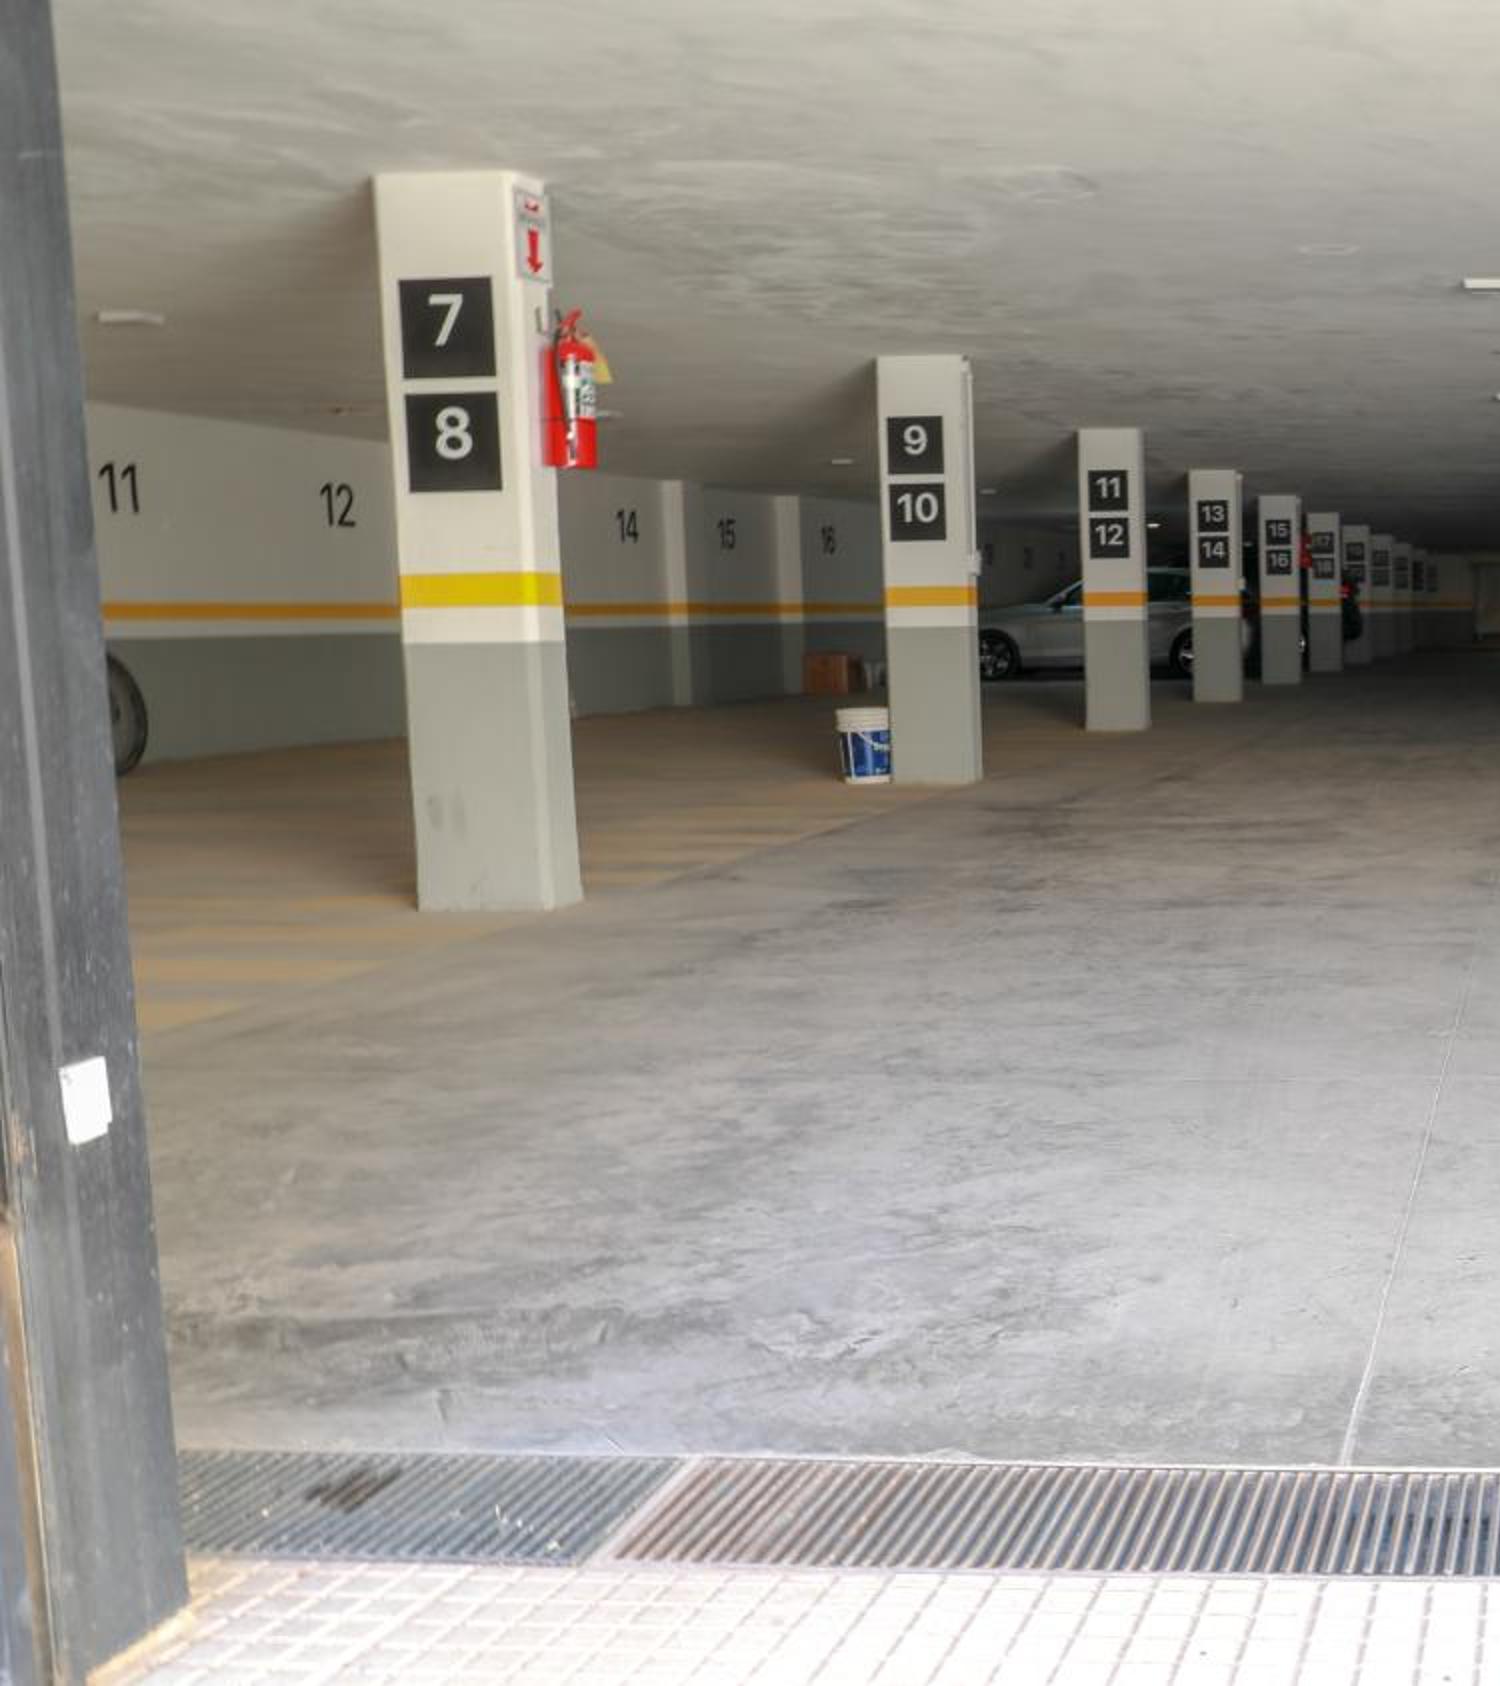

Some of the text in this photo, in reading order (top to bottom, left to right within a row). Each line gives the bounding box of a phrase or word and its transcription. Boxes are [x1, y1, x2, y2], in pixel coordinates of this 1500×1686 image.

[429, 293, 463, 346] 7
[435, 406, 473, 460] 8
[903, 425, 928, 455] 9
[98, 462, 139, 514] 11
[1096, 477, 1120, 498] 11
[320, 483, 356, 528] 12
[897, 492, 939, 523] 10
[1202, 505, 1225, 523] 13
[616, 509, 640, 543] 14
[1095, 523, 1124, 546] 12
[1269, 522, 1288, 538] 15
[1202, 541, 1225, 558] 14
[1270, 553, 1289, 567] 16
